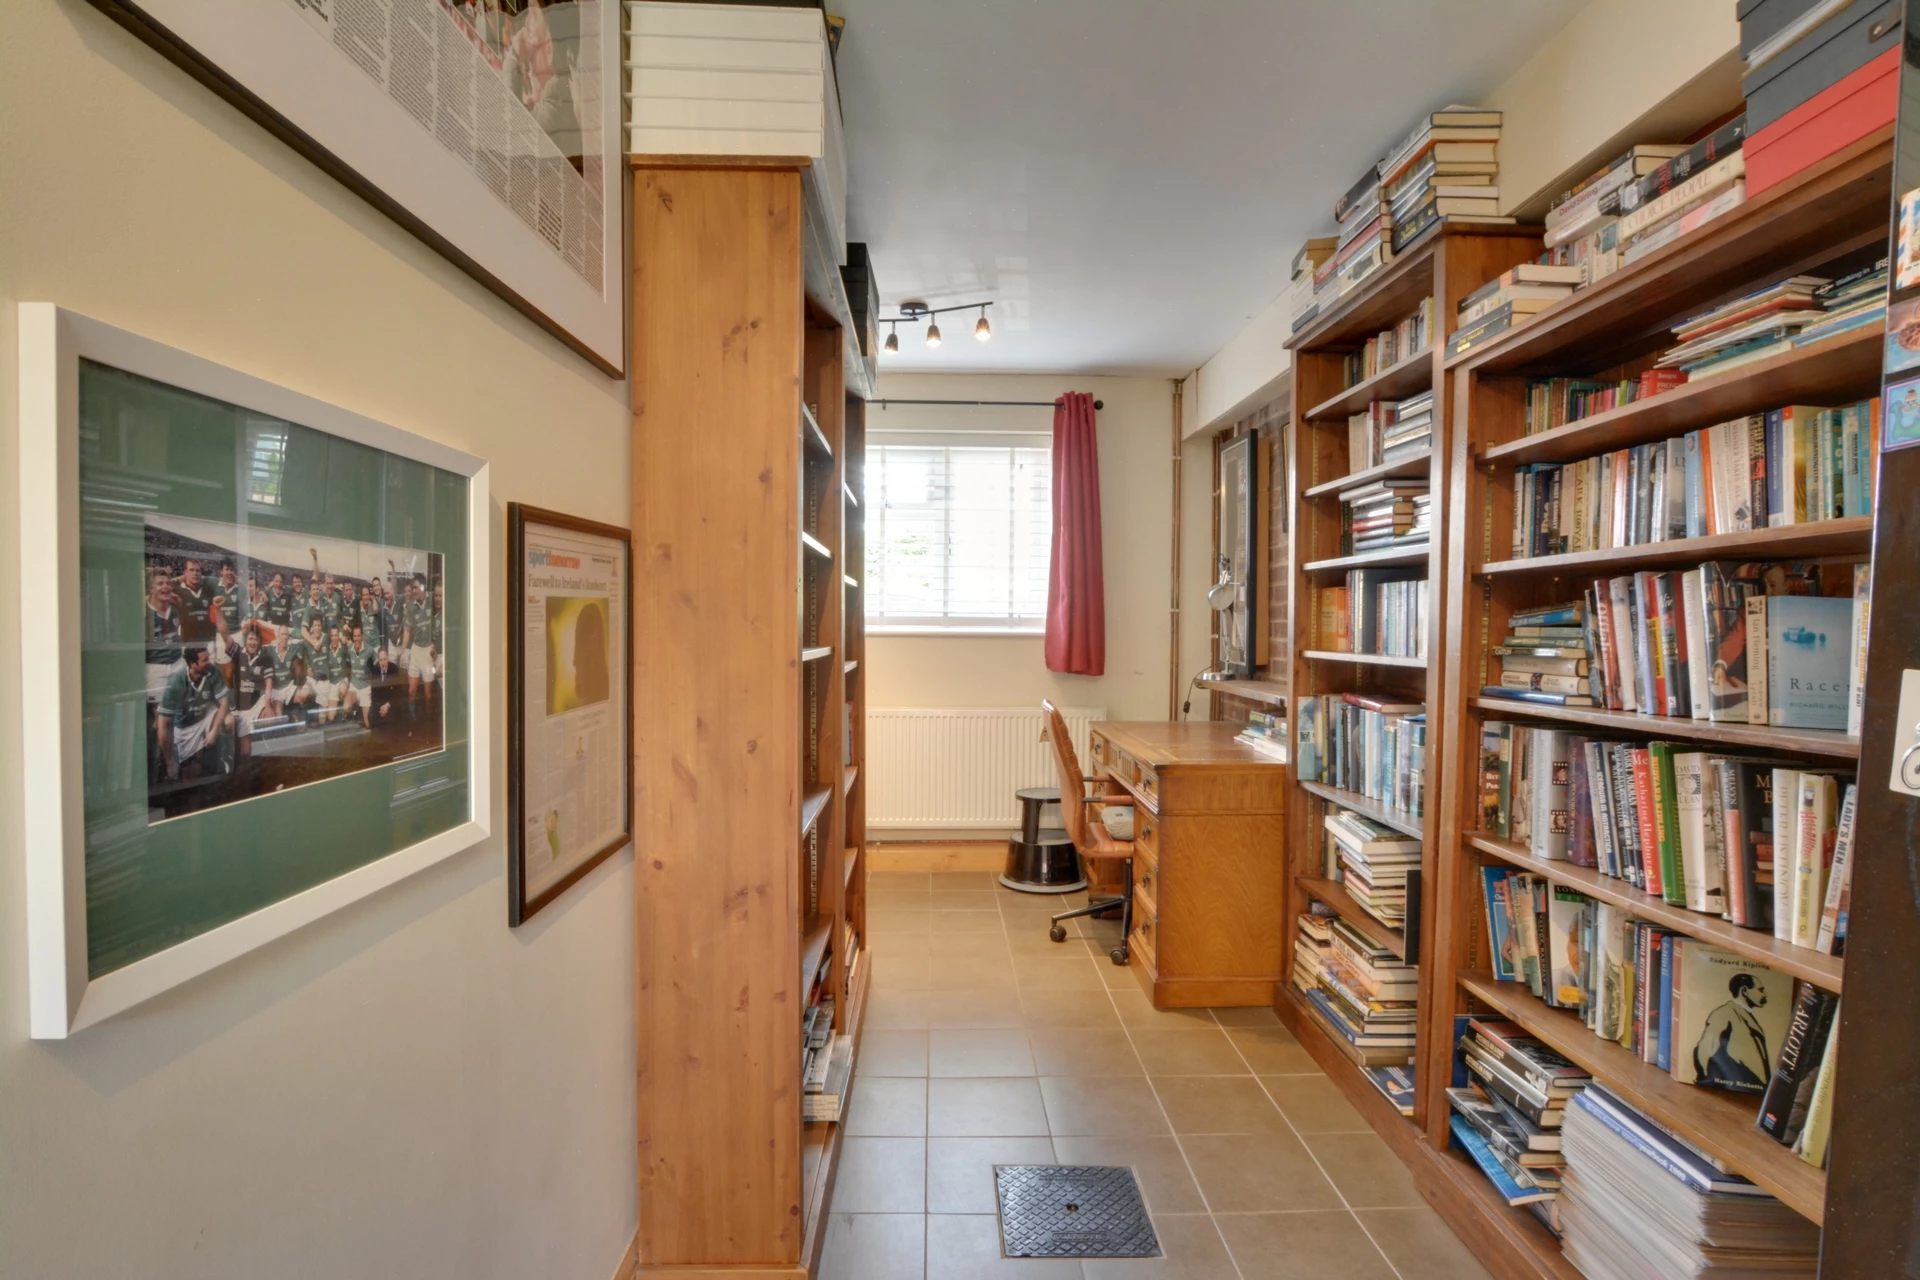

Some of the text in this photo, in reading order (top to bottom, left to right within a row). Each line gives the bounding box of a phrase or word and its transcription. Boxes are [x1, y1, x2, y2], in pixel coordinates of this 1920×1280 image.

[1558, 201, 1576, 217] David
[1576, 186, 1598, 205] Stirling
[1628, 197, 1669, 230] CHOICE
[1670, 170, 1712, 206] PEOPLE
[1575, 478, 1583, 505] ARK
[528, 574, 555, 588] Farewell
[555, 577, 561, 588] to
[1752, 618, 1762, 671] Ian Fleming
[1632, 753, 1649, 766] Me
[1675, 764, 1701, 777] DAVID
[1596, 771, 1608, 803] ICEBOUND
[1625, 774, 1637, 806] NORMAN
[1652, 755, 1665, 842] RUDYARD KIPLING
[1677, 793, 1701, 805] LEAN
[1722, 772, 1730, 803] BRAGG
[1727, 769, 1738, 805] MELVYN
[1600, 804, 1609, 812] IN
[1637, 771, 1654, 871] Katharine Hepburn
[1600, 813, 1612, 854] ANTARCTICA
[1712, 790, 1726, 871] GREGORY PECK
[1835, 801, 1855, 865] LADY'S MEN
[1779, 786, 1789, 908] PETER USTINOV
[1709, 956, 1771, 971] Rudyard Kipling
[1782, 1005, 1810, 1071] ARLOTT
[1714, 1077, 1764, 1091] Harry Ricketts
